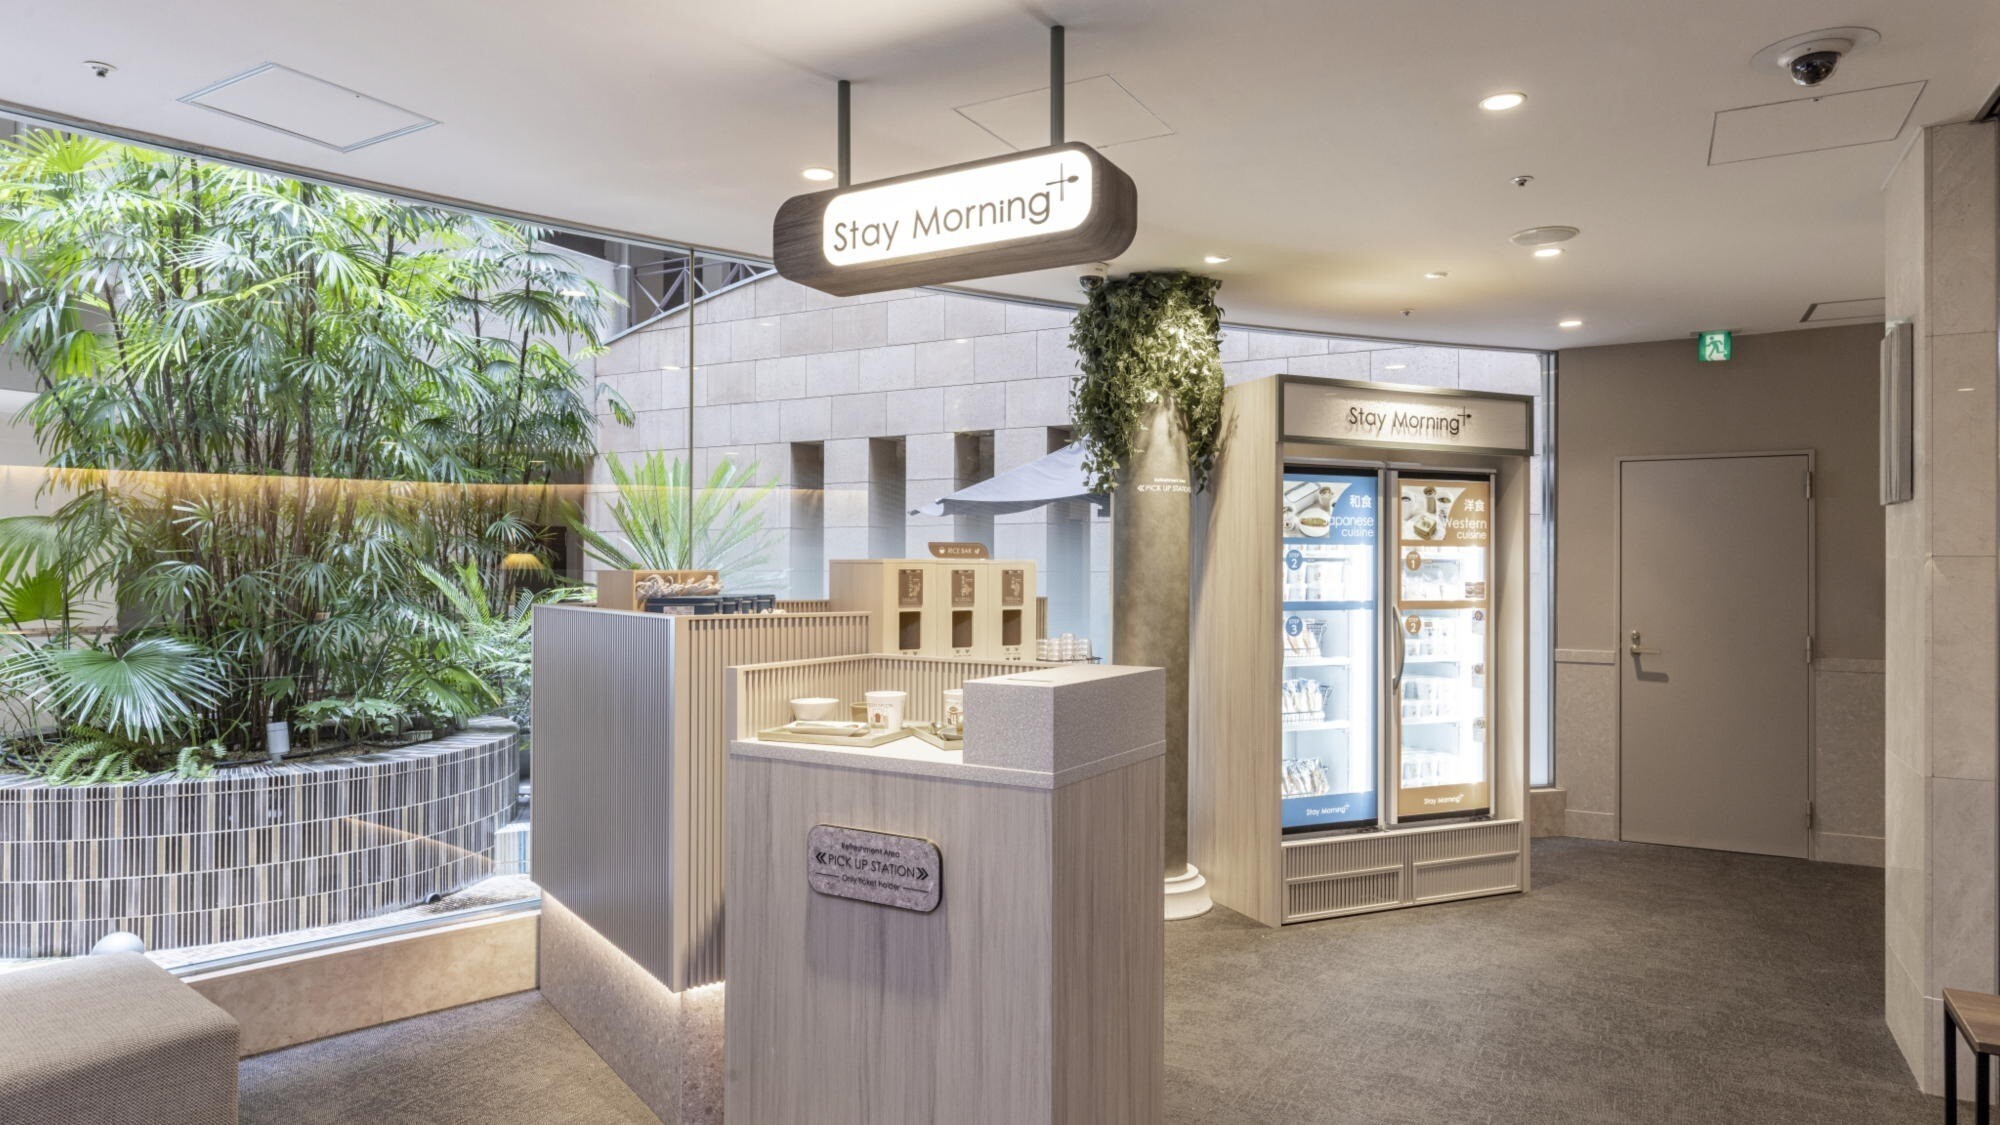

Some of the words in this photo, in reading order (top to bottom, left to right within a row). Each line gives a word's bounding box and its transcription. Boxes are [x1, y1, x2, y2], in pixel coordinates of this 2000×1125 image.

[834, 220, 899, 252] Stay
[1349, 406, 1387, 432] Stay
[1349, 494, 1372, 508] 和食
[1463, 498, 1486, 512] 洋食
[1341, 527, 1375, 538] cuisine
[1306, 807, 1320, 816] Stay
[883, 849, 901, 858] Area
[828, 853, 852, 868] PICK
[854, 860, 868, 870] UP
[871, 861, 915, 877] STATION
